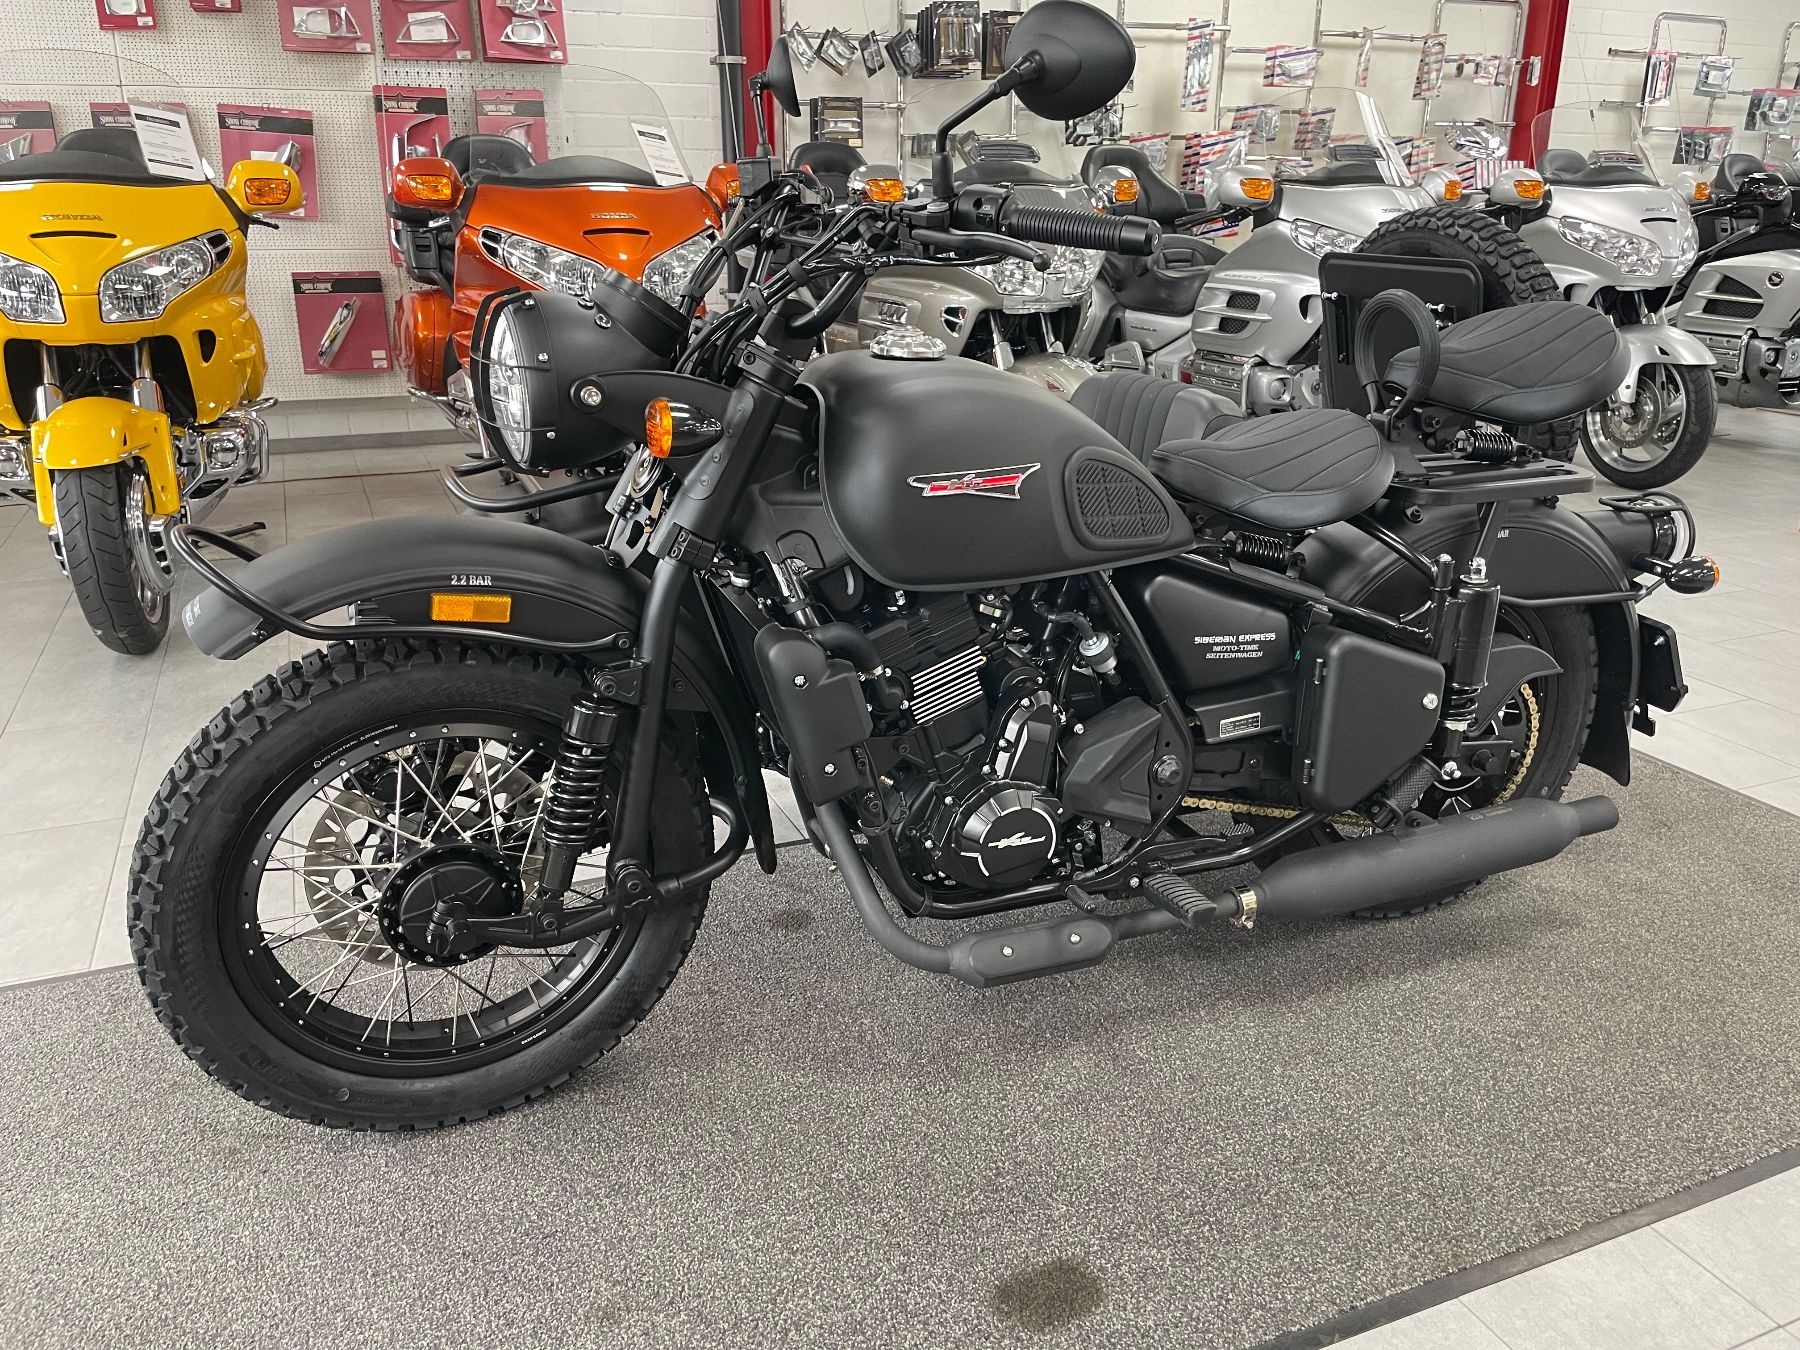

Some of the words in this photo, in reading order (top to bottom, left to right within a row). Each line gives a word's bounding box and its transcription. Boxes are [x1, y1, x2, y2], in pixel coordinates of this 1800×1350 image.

[451, 574, 467, 586] 2.2
[469, 575, 492, 586] BAR
[1194, 635, 1236, 645] SIBERIAN
[1239, 632, 1276, 642] EXPRESS
[1205, 651, 1263, 659] SEITENWAGEN
